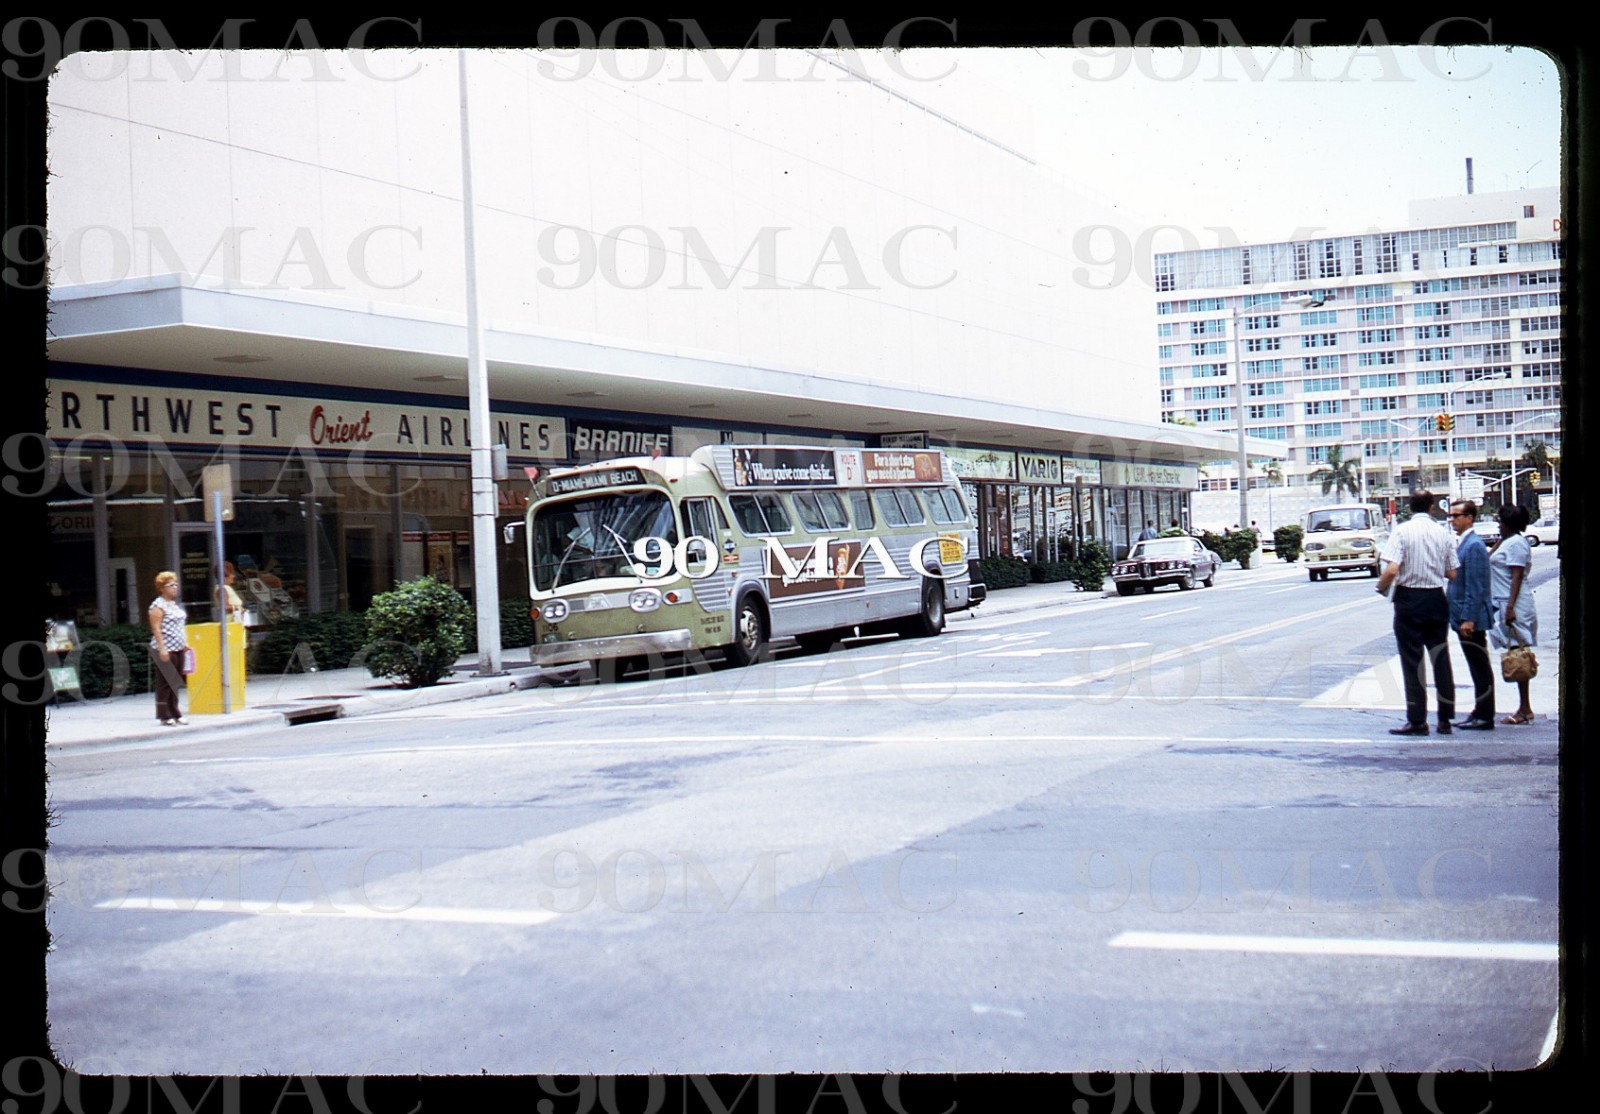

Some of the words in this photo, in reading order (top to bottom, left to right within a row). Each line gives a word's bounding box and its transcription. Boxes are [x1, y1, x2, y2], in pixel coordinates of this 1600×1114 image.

[309, 405, 373, 445] Orient
[397, 413, 550, 451] AIRLNES
[573, 426, 669, 454] BRANIFF
[840, 454, 856, 465] ROUTE
[1021, 456, 1058, 479] VARIG
[610, 470, 638, 485] BEACH
[751, 462, 773, 480] When
[793, 467, 809, 480] come
[809, 463, 821, 480] this
